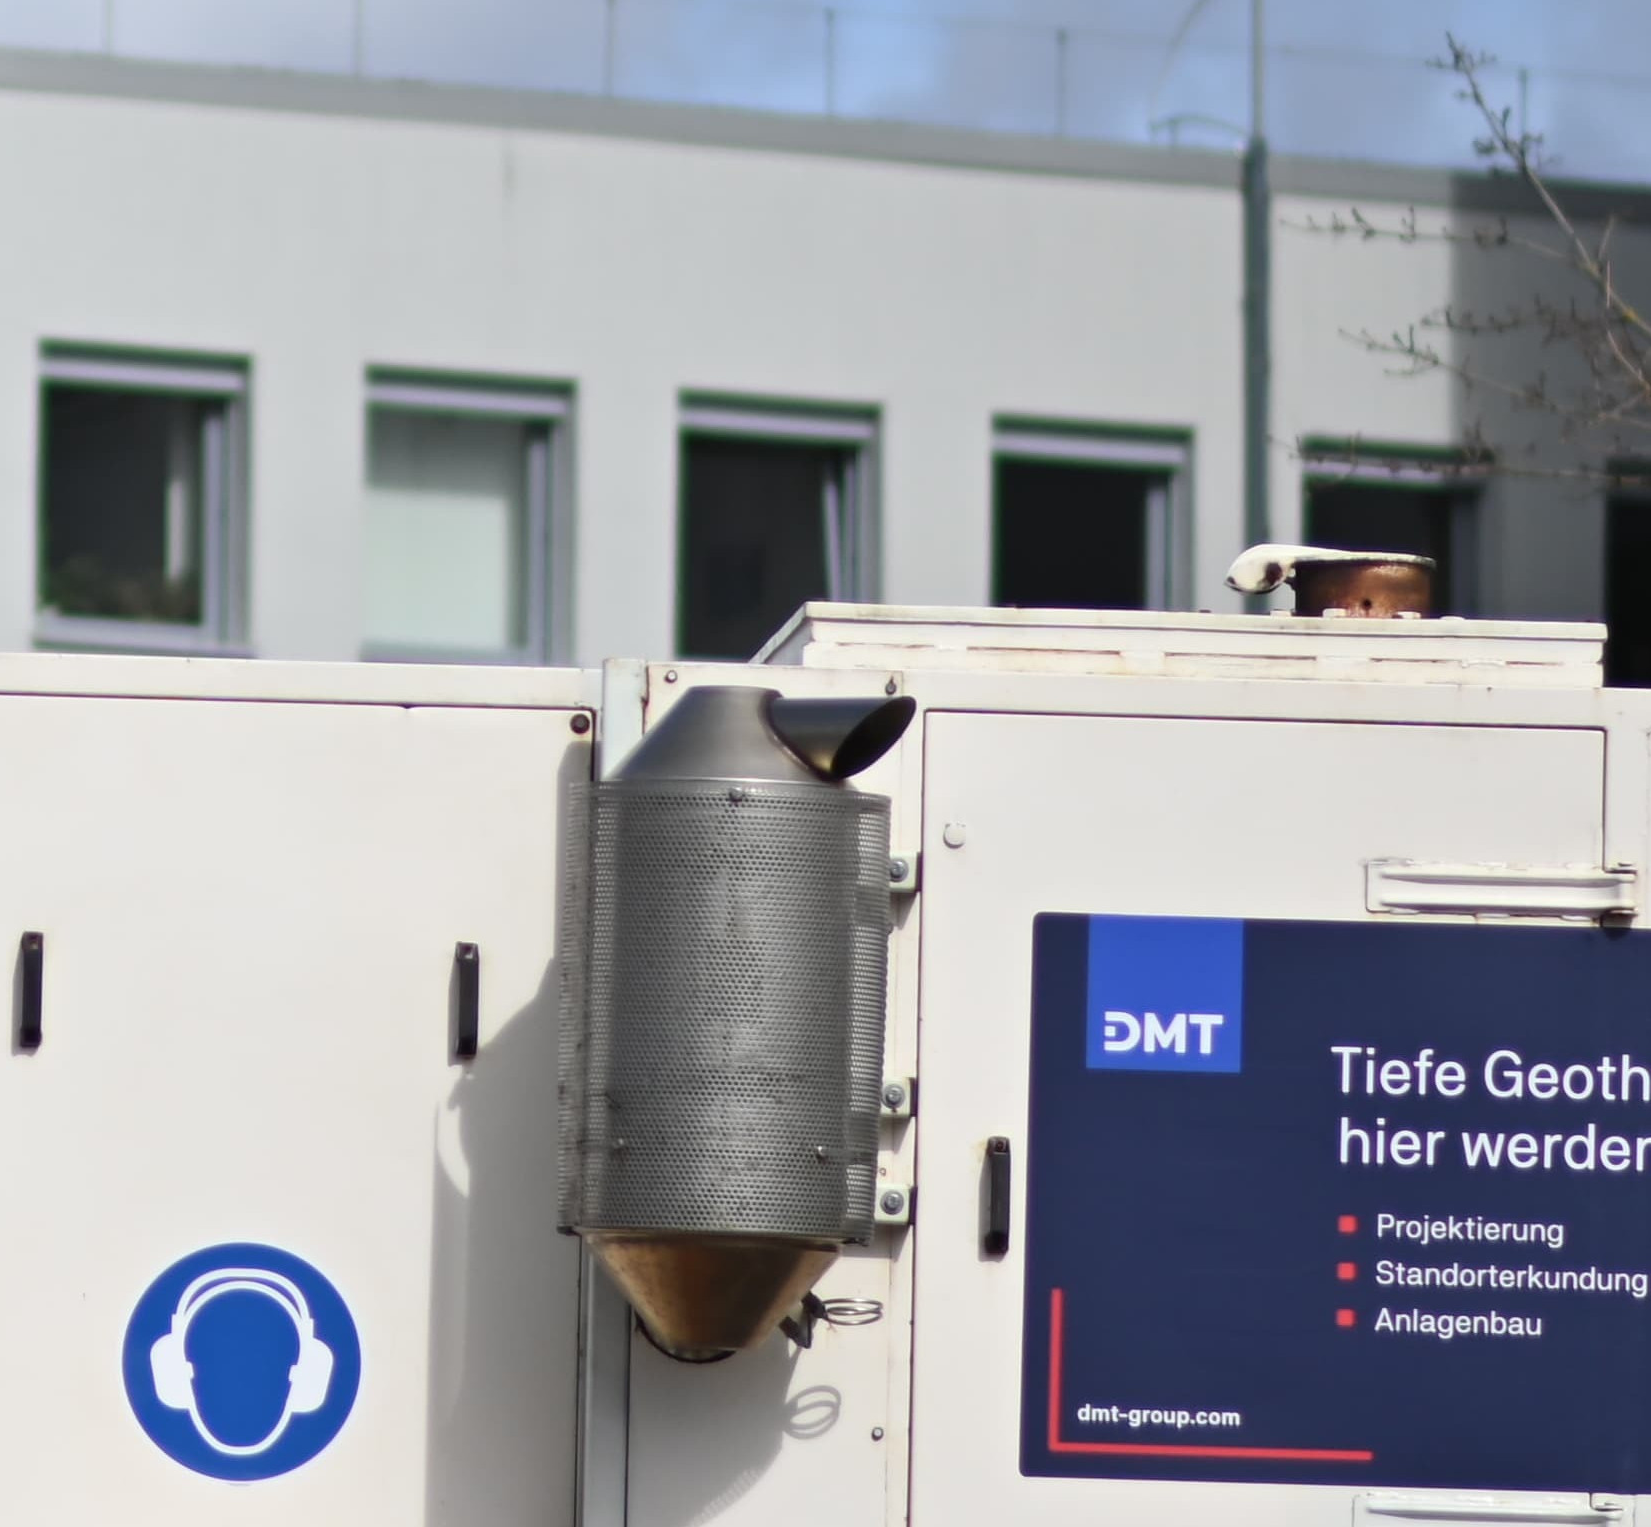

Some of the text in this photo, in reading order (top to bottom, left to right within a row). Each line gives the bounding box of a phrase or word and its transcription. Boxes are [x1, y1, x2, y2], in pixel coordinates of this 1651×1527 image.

[1103, 1010, 1224, 1056] DMT
[1330, 1046, 1467, 1097] Tiefe
[1339, 1116, 1447, 1166] hier
[1376, 1212, 1565, 1250] Projektierung
[1375, 1258, 1649, 1300] Standorterkundung
[1373, 1306, 1543, 1341] Anlagenbau
[1077, 1402, 1242, 1430] dmt-group.com
